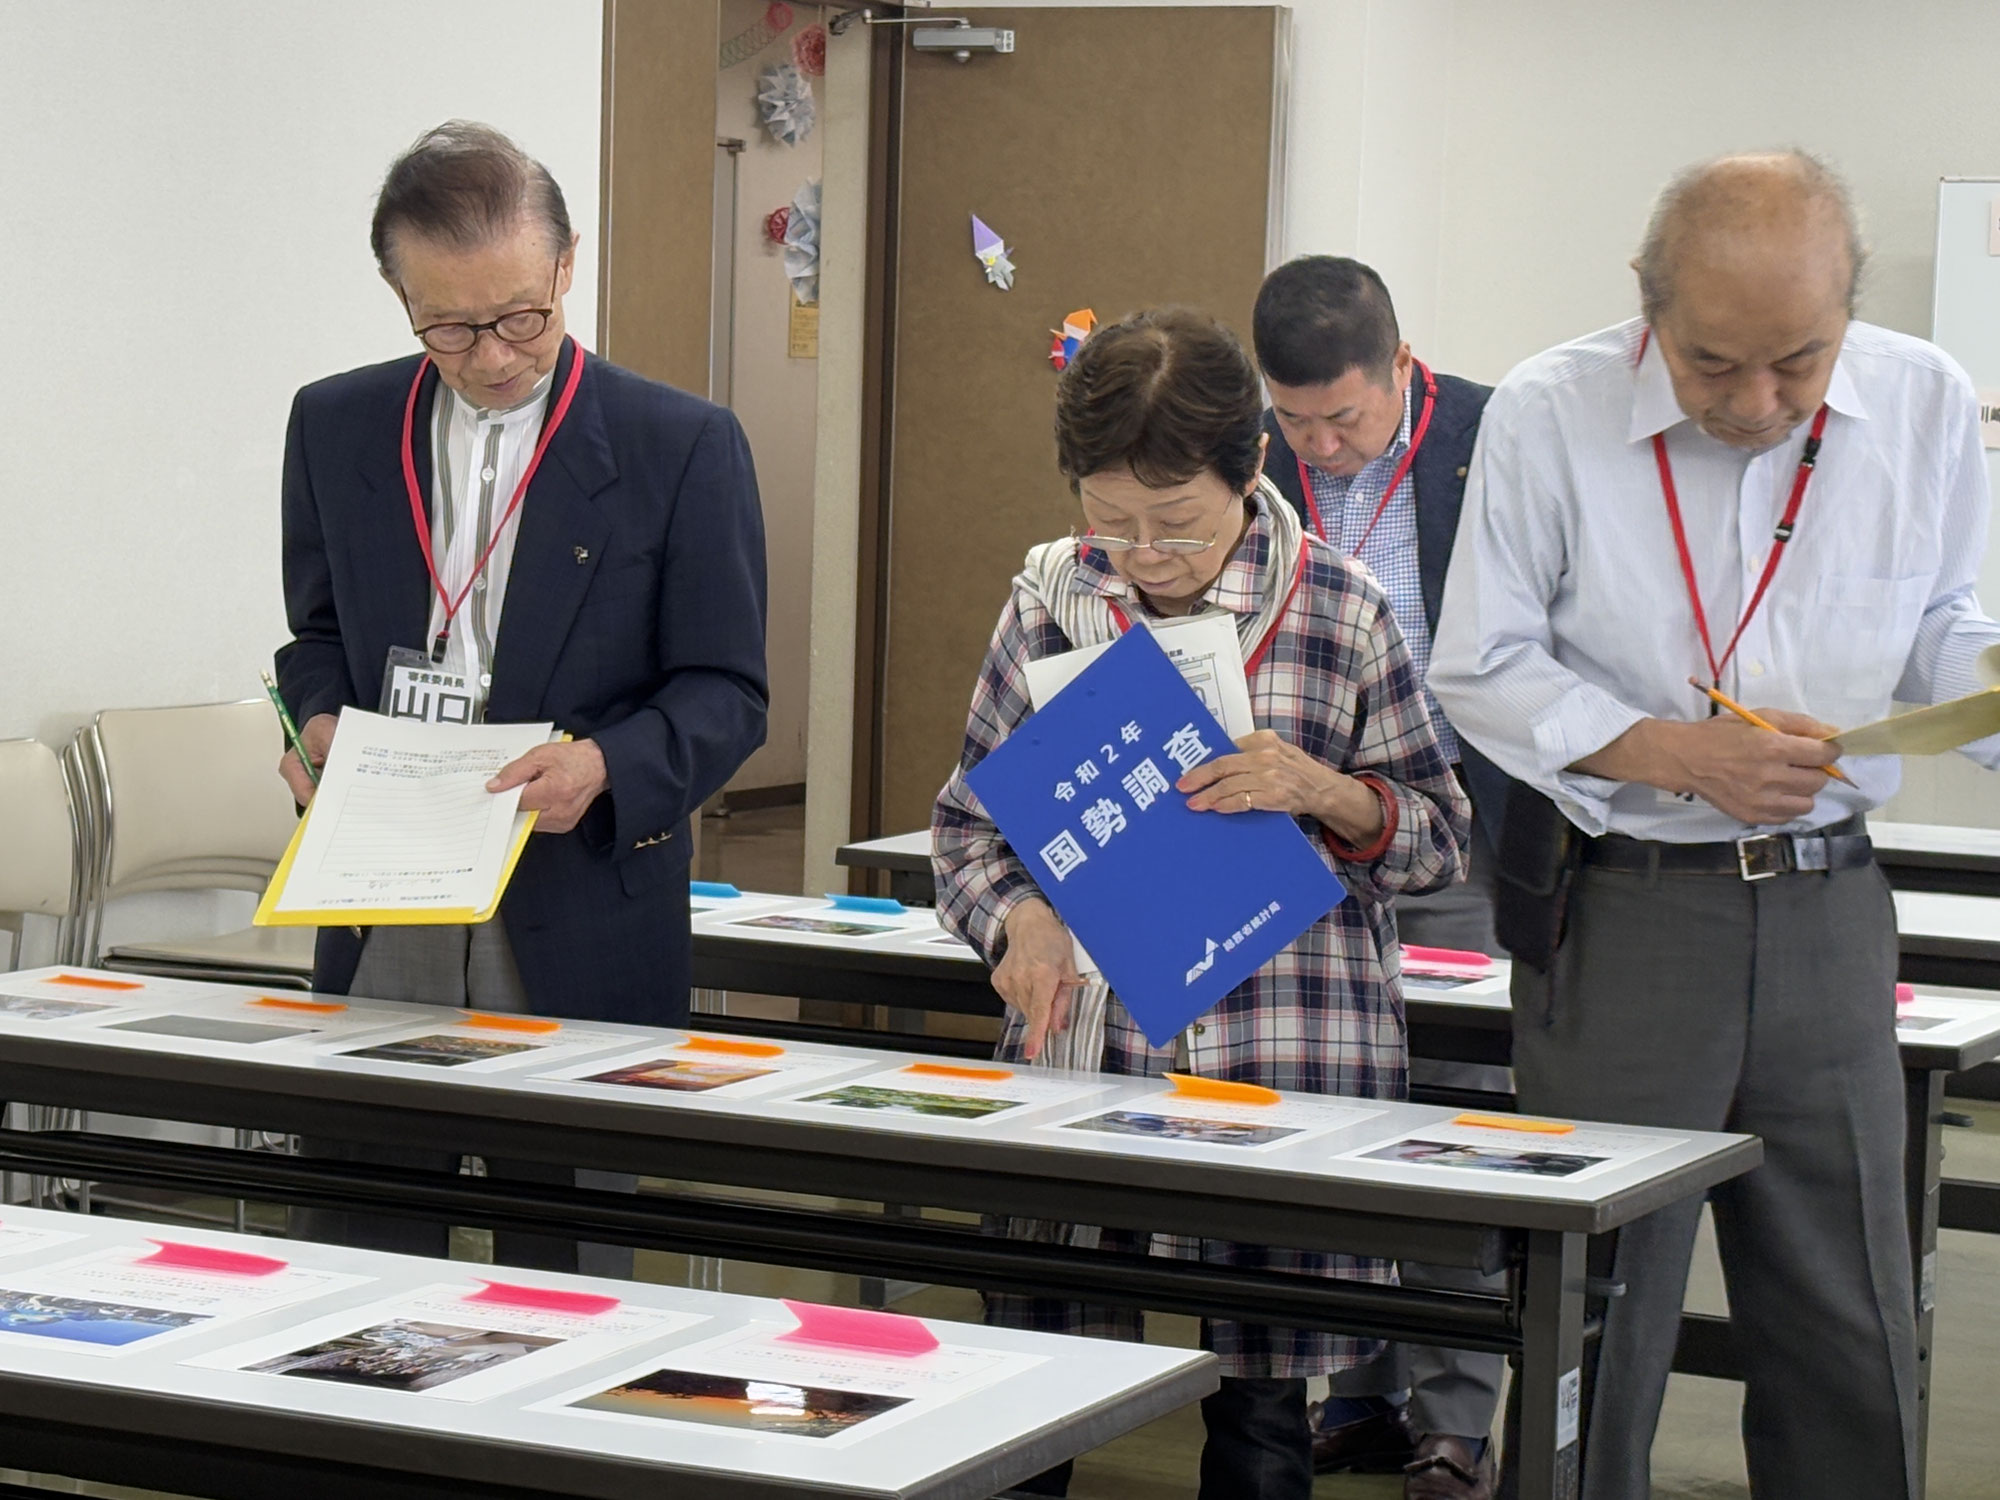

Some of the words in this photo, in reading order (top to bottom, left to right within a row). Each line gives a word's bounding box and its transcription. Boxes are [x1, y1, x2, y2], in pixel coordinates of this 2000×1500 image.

[391, 685, 471, 725] 山口
[408, 671, 465, 688] 審査委員長
[1054, 720, 1143, 802] 令和2年
[1039, 722, 1212, 882] 国勢調査
